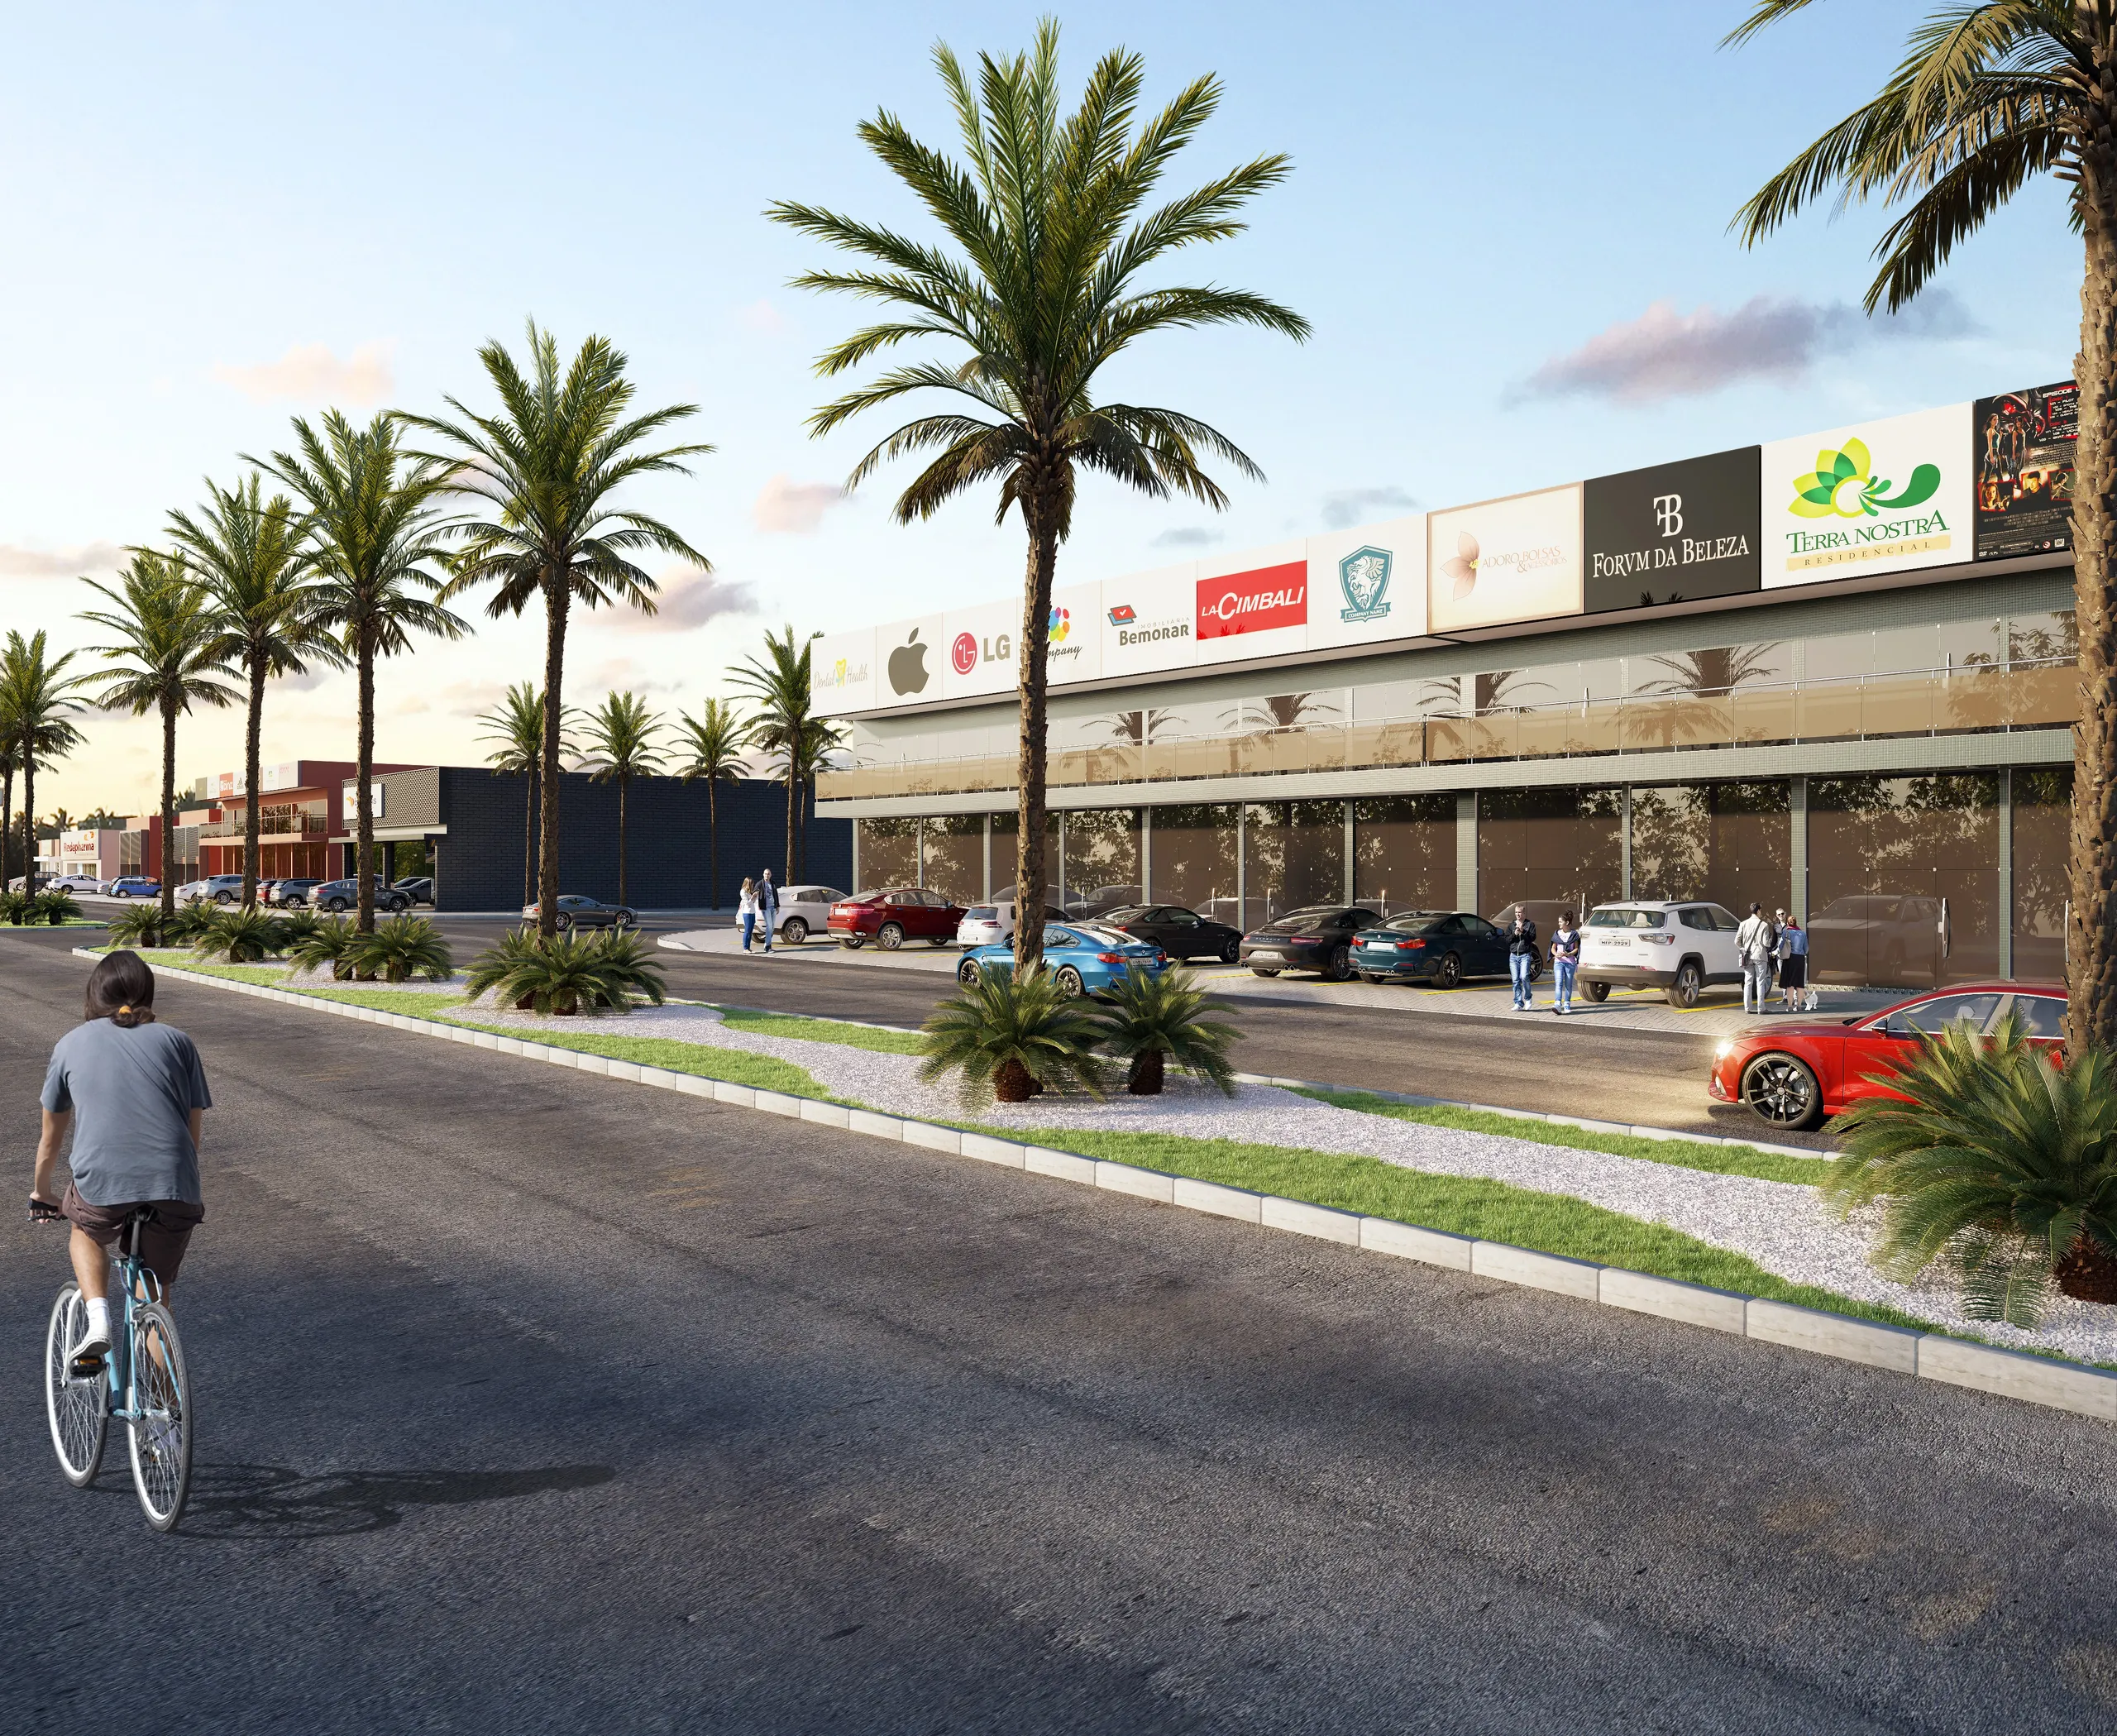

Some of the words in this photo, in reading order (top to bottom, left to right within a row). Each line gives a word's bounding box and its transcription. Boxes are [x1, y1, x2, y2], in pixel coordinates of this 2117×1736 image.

[1786, 531, 1852, 554] TERRA
[1854, 509, 1951, 544] NOSTRA
[1482, 552, 1520, 569] ADORO
[1593, 550, 1651, 578] FORVM
[1654, 546, 1678, 569] DA
[1681, 534, 1750, 564] BELEZA
[1804, 541, 1931, 567] RESIDENCIAL
[1217, 586, 1304, 620] CIMBALI
[983, 634, 1011, 662] LG
[814, 668, 836, 690] Dental
[847, 663, 868, 685] Health
